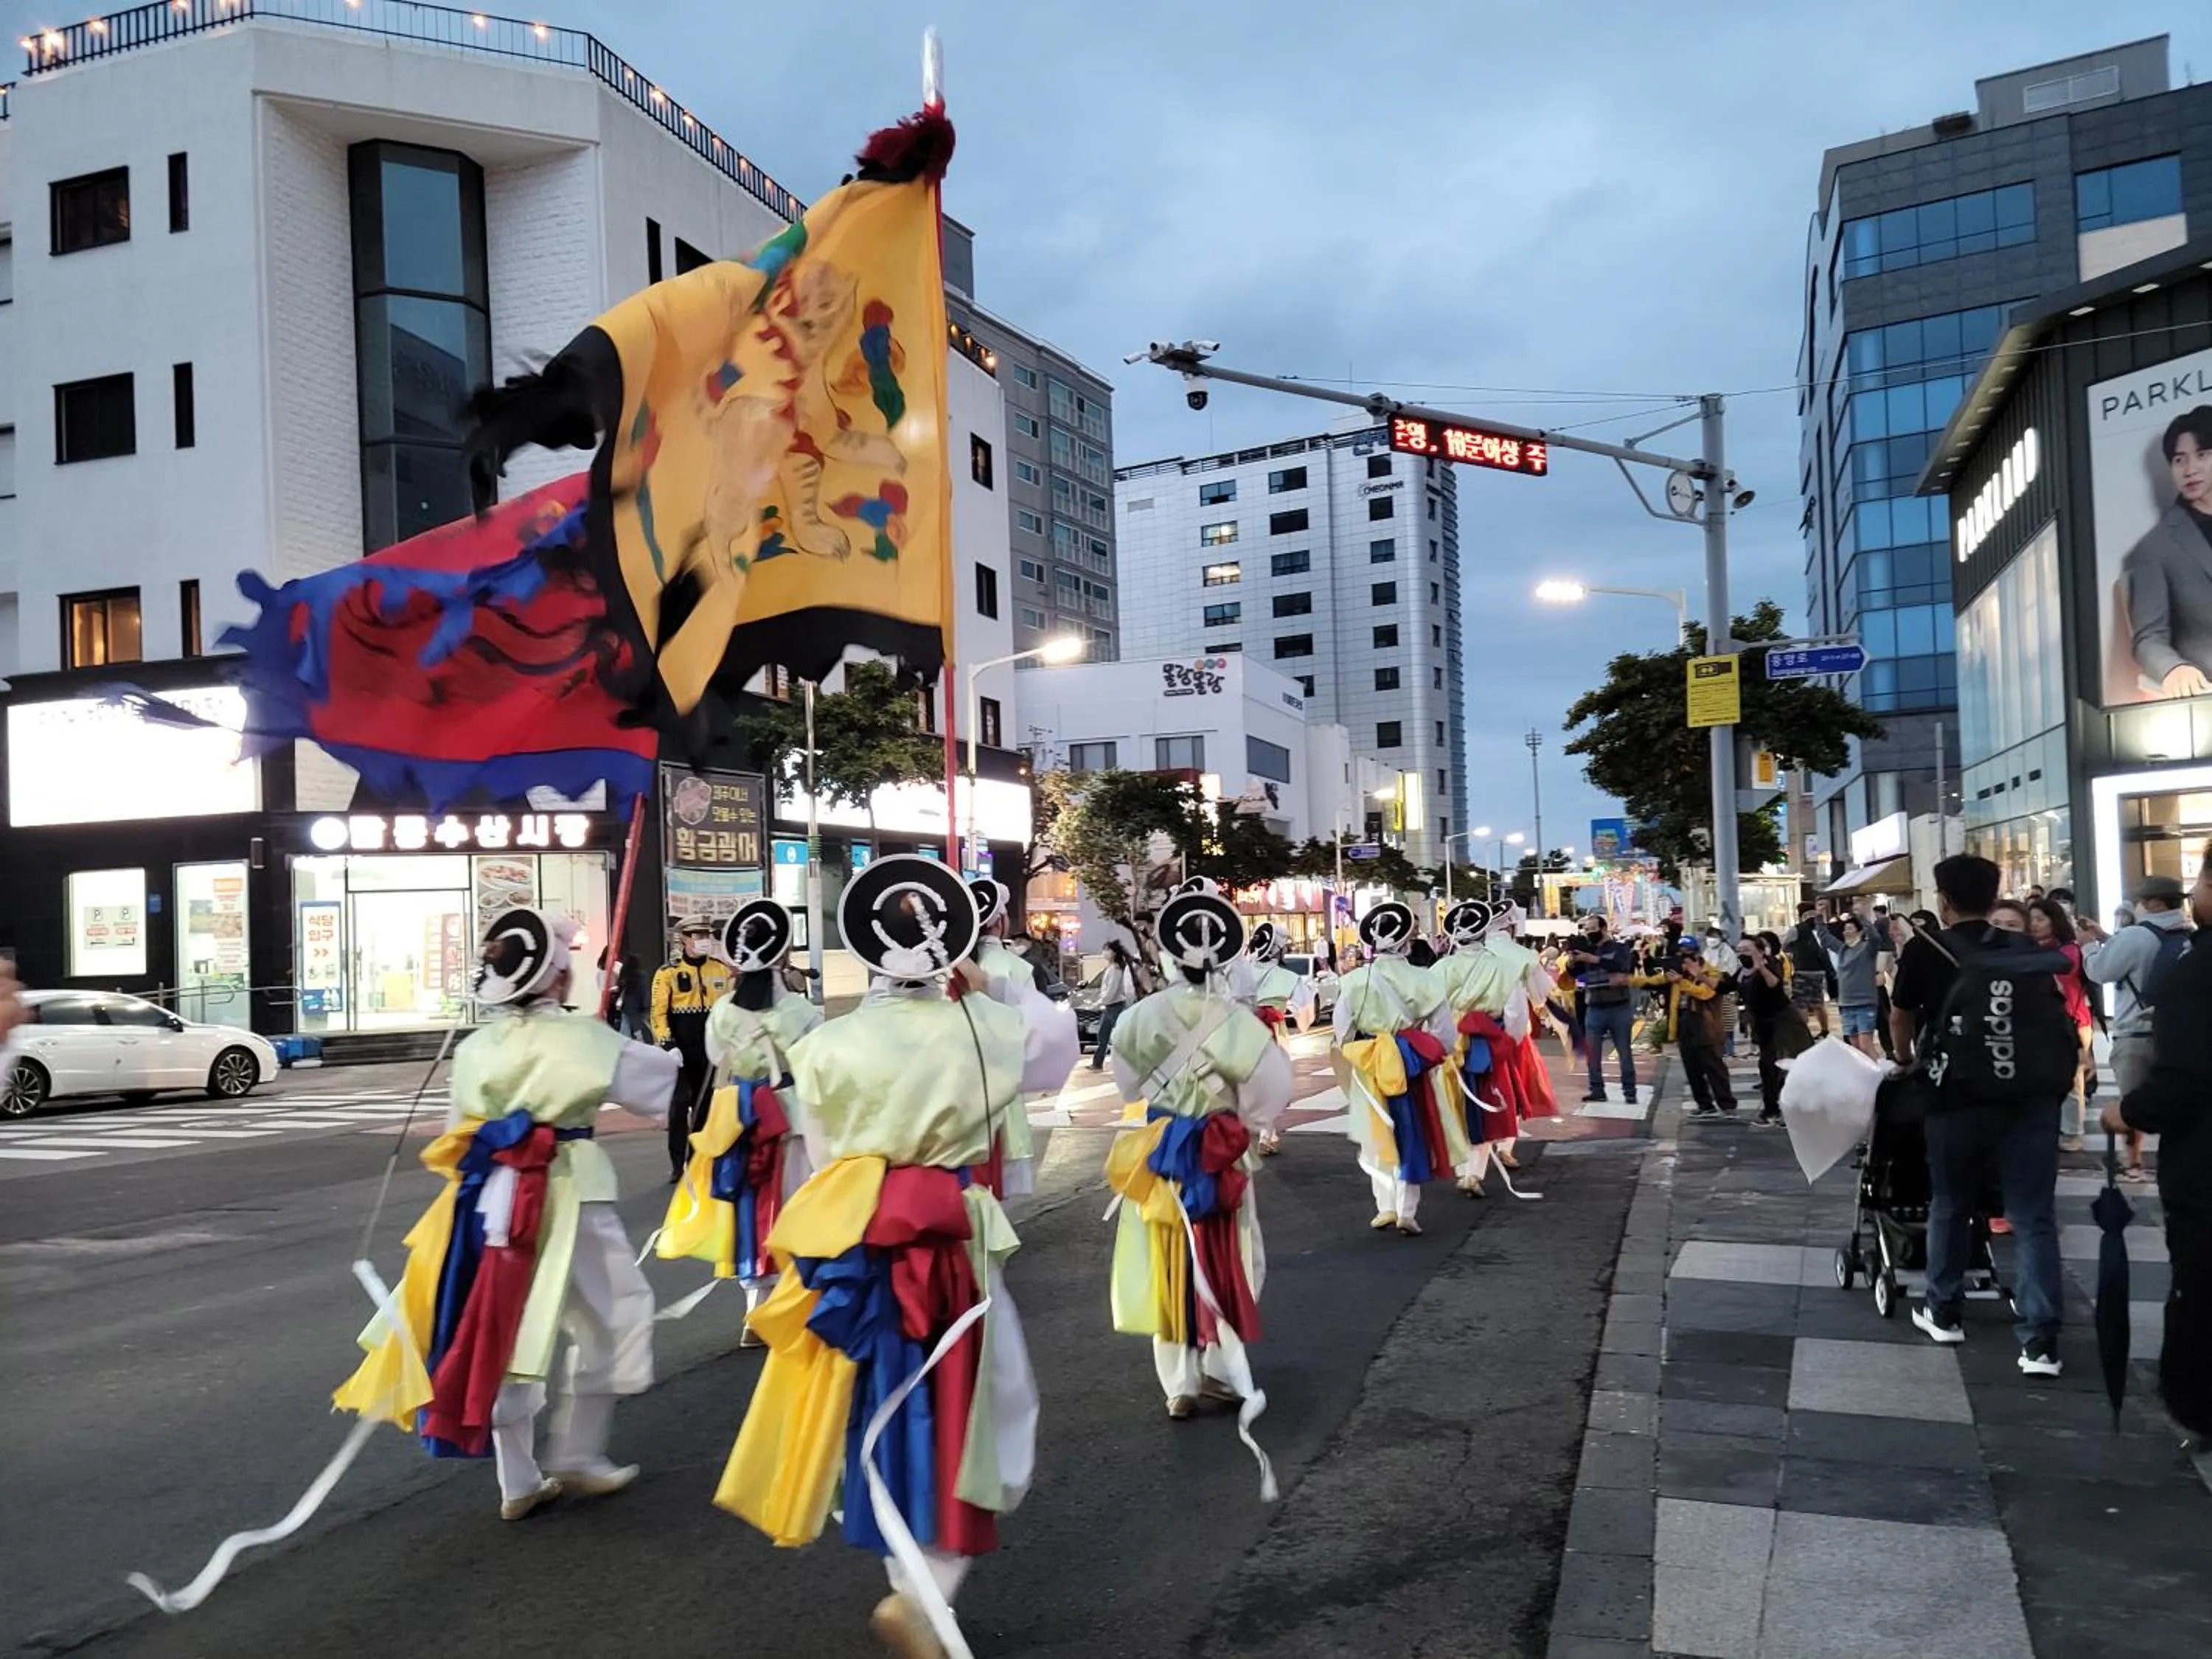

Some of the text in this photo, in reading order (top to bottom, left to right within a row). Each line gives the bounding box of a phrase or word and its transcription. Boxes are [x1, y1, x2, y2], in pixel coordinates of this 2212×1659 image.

[2101, 369, 2212, 420] PARKL
[308, 914, 334, 927] 식당
[1983, 980, 2016, 1079] adidas
